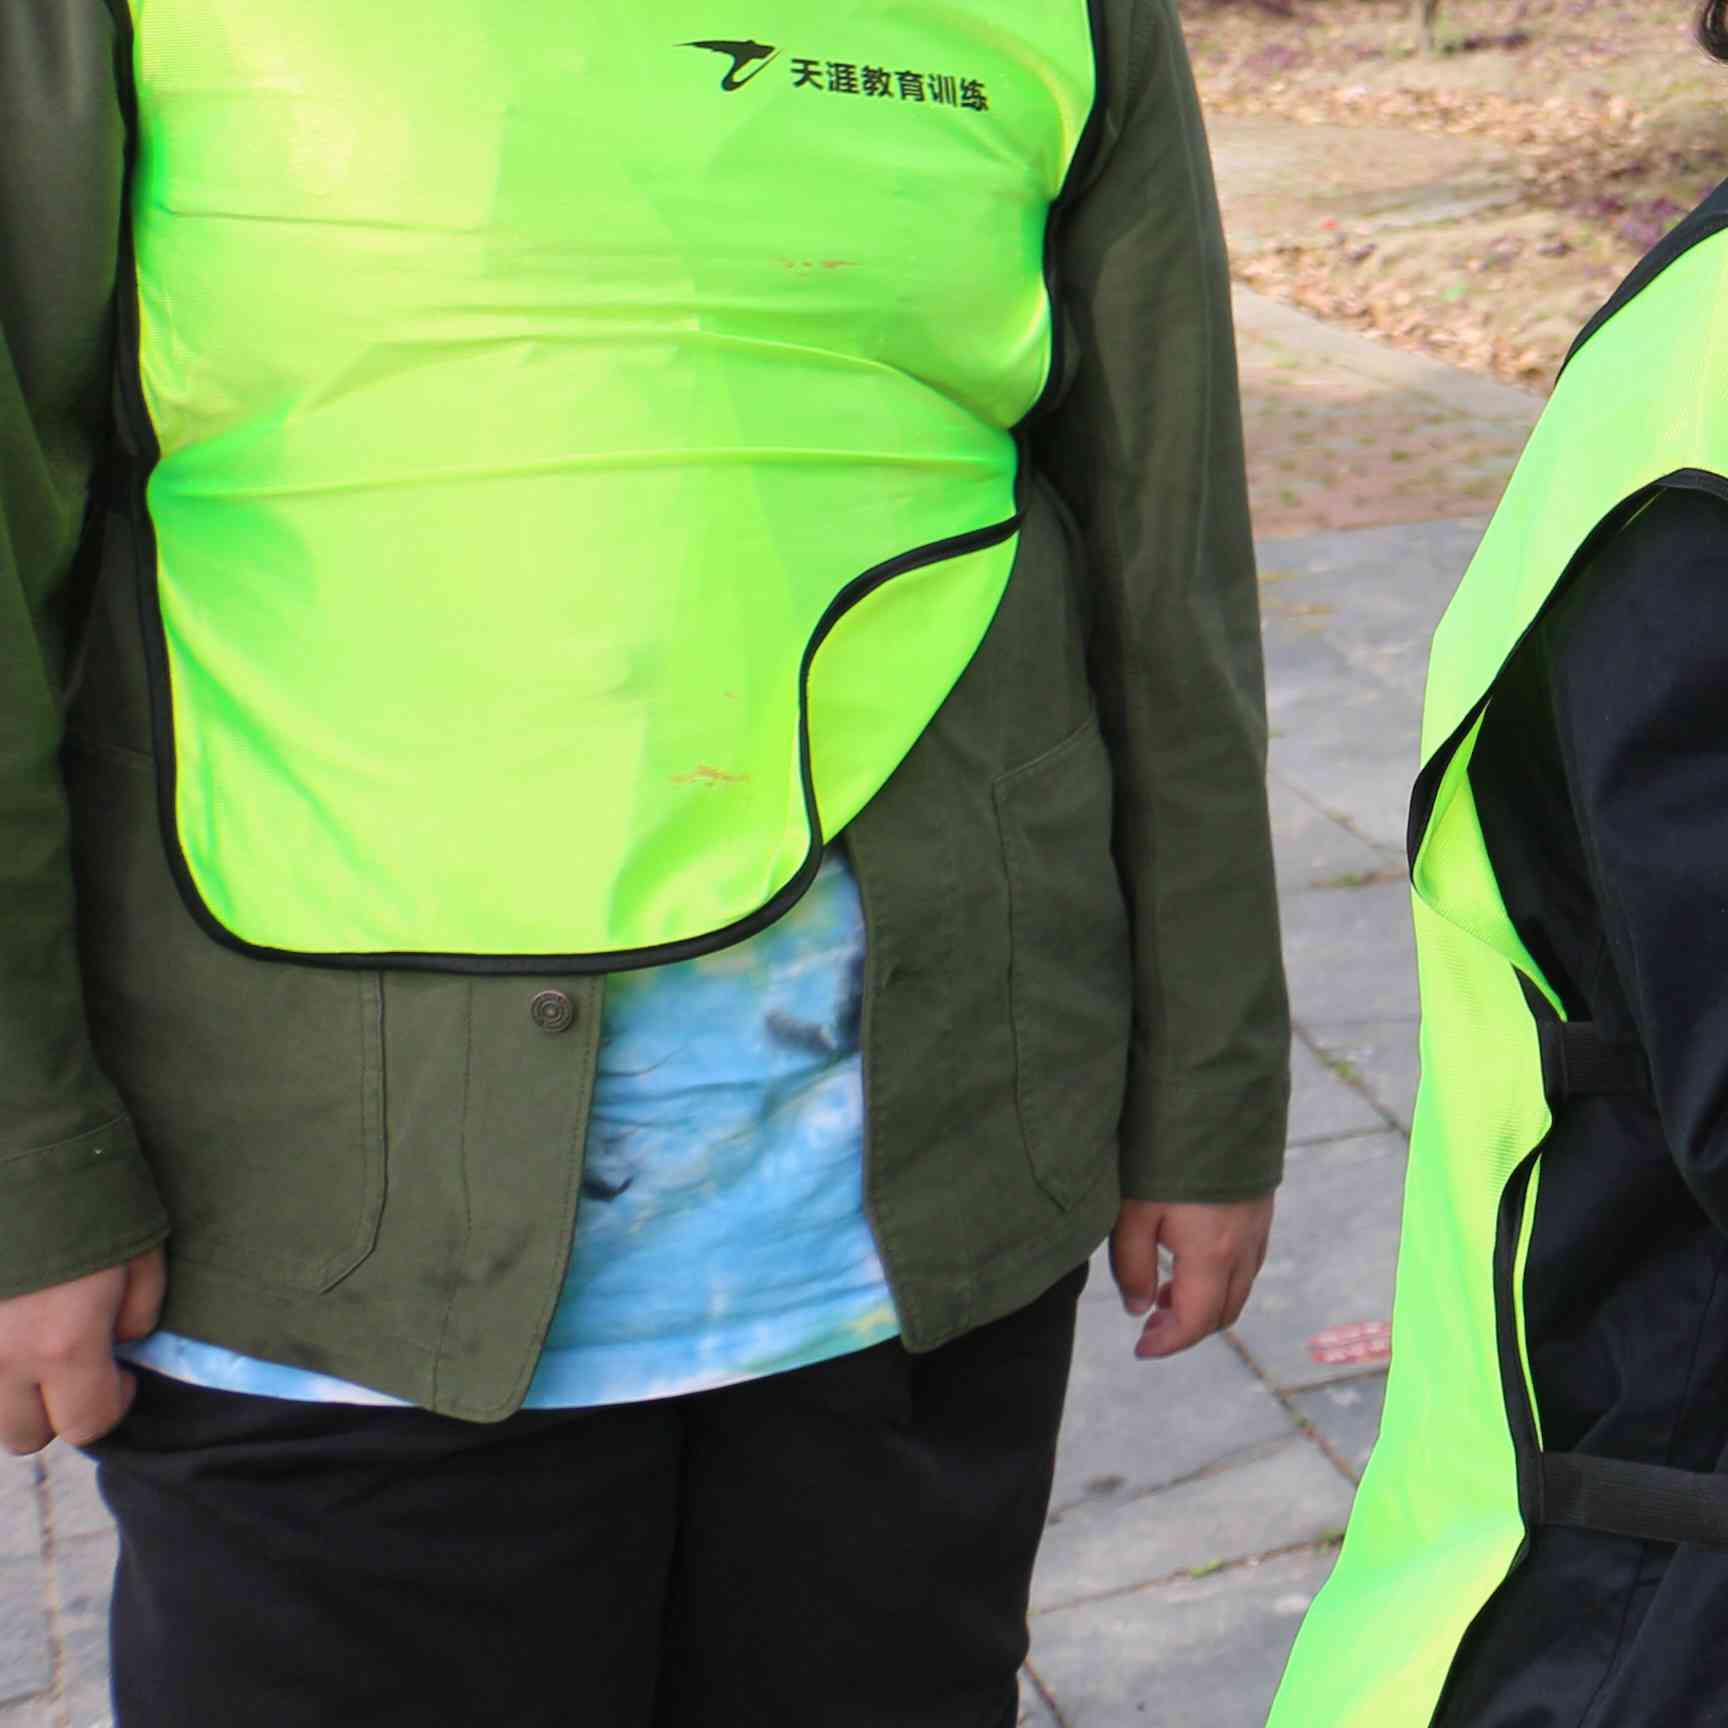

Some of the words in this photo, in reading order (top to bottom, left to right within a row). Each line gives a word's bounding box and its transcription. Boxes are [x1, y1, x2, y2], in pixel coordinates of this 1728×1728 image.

[790, 57, 989, 112] 天涯教育训练
